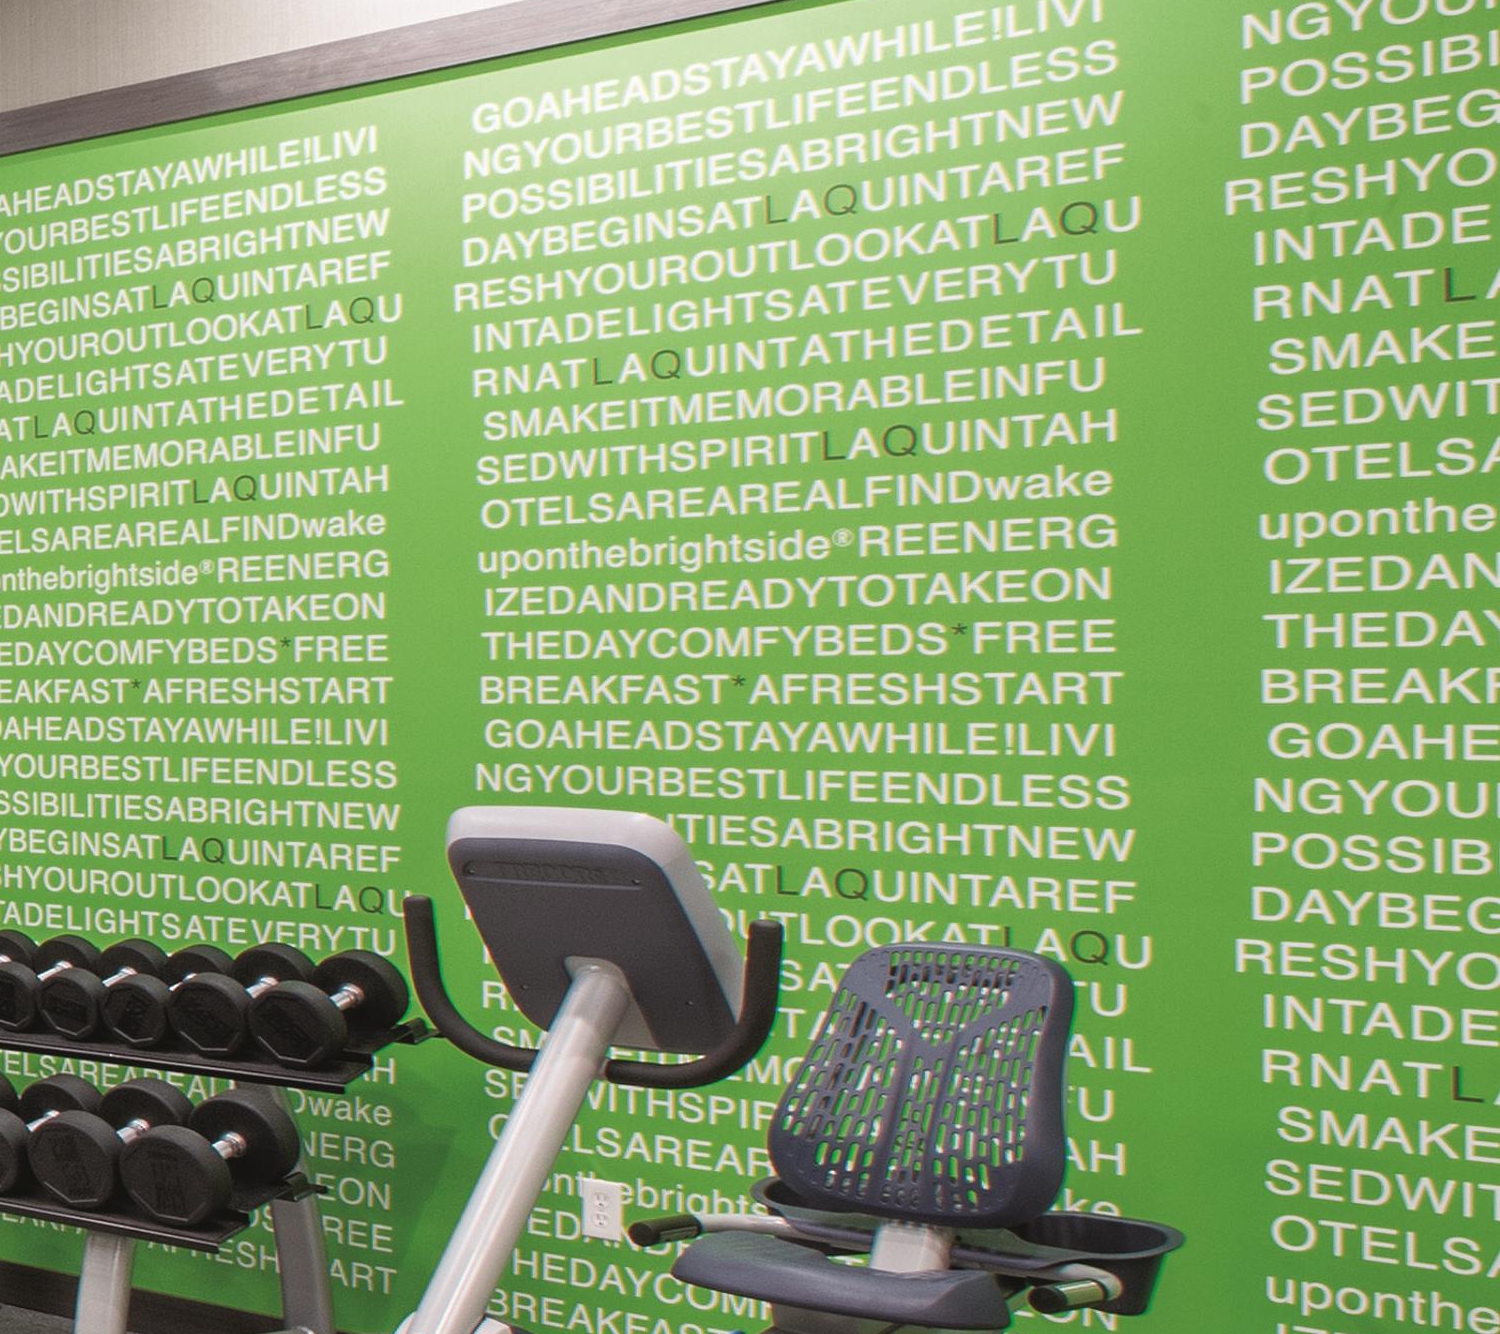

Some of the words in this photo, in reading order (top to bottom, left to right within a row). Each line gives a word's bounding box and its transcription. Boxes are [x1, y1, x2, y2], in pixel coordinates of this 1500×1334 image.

[464, 40, 1116, 179] NGYOURBESTLIFEENDLESS
[462, 91, 1122, 223] POSSIBILITIESABRIGHTNEW
[462, 144, 1123, 267] DAYBEGINSATLAQUINTAREF
[454, 196, 1139, 312] RESHYOUROUTLOOKATLAQU
[473, 250, 1114, 352] INTADELIGHTSATEVERYTU
[473, 303, 1141, 397] RNATLAQUINTATHEDETAIL
[484, 357, 1102, 440] SMAKEITMEMORABLEINFU
[477, 409, 1115, 485] SEDWITHSPIRITLAQUINTAH
[481, 465, 1111, 529] OTELSAREAREALFINDwake
[485, 567, 1109, 616] IZEDANDREADYTOTAKEON
[485, 719, 1113, 756] GOAHEADSTAYAWHILE!LIVI
[476, 763, 1128, 810] NGYOURBESTLIFEENDLESS
